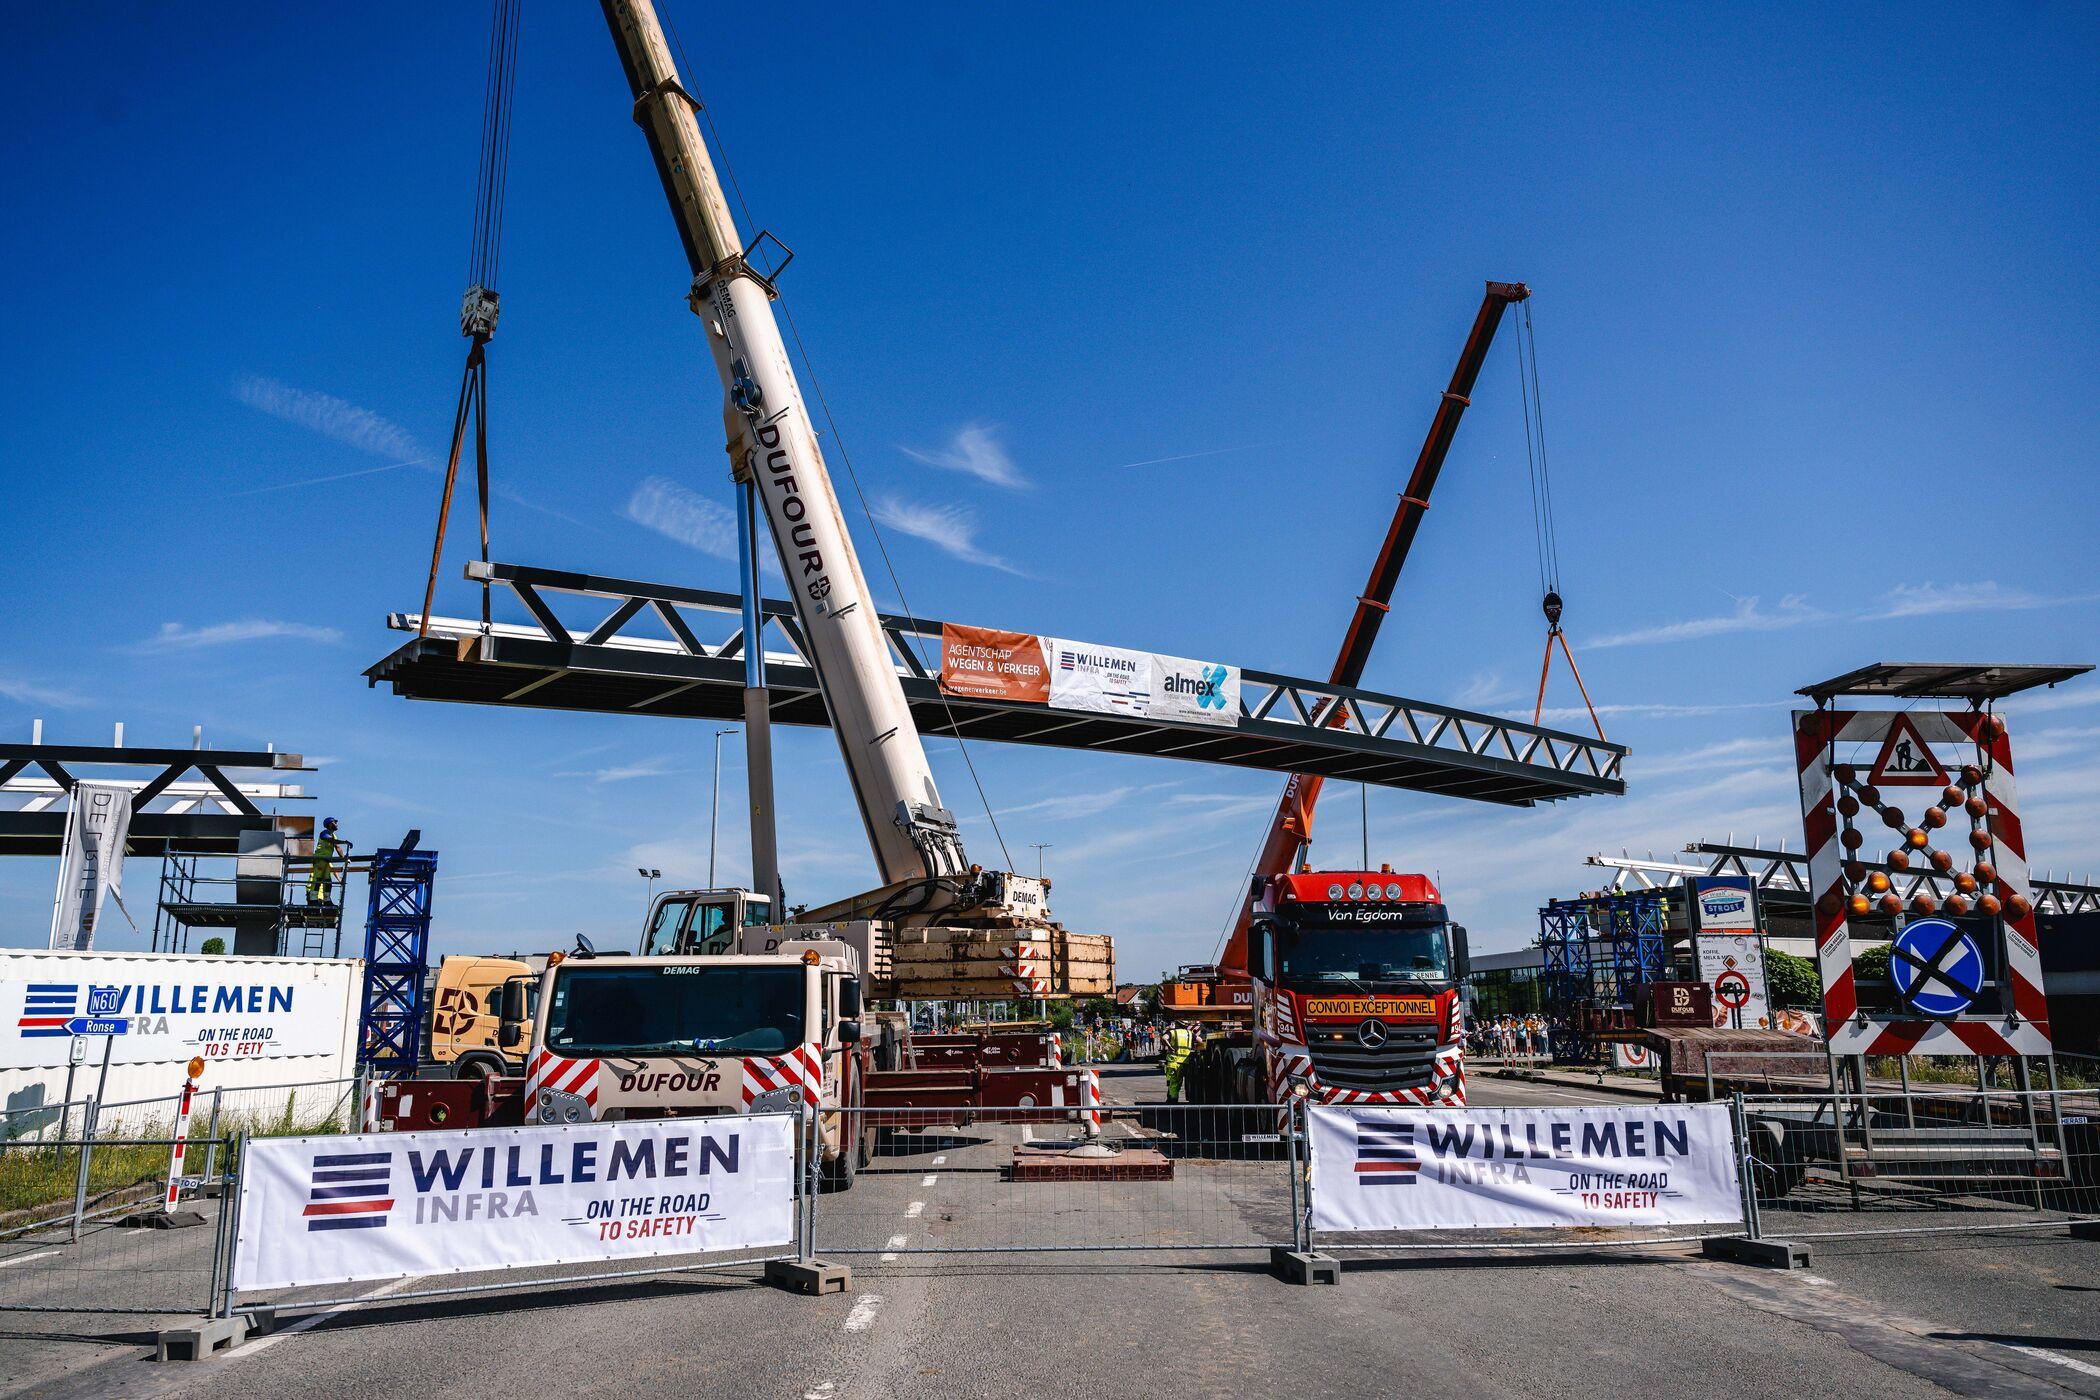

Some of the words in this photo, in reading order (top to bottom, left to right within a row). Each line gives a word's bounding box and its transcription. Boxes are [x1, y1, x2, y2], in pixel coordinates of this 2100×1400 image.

[717, 280, 736, 317] DEMAG
[757, 424, 824, 577] DUFOUR
[948, 643, 1012, 660] AGENTSCHAP
[948, 657, 984, 671] WEGEN
[986, 661, 994, 672] &
[997, 662, 1040, 676] VERKEER
[1077, 653, 1136, 672] WILLEMEN
[1077, 664, 1100, 674] INFRA
[1164, 672, 1216, 697] almex
[1012, 891, 1037, 905] DEMAG
[1708, 903, 1740, 912] STROET
[1328, 909, 1353, 921] Van
[1355, 909, 1403, 923] Egdom
[663, 966, 700, 975] DEMAG
[92, 992, 117, 1011] N60
[1307, 1001, 1350, 1014] CONVOI
[1354, 1001, 1435, 1014] EXCEPTIONNEL
[86, 1020, 115, 1033] Ronse
[198, 1028, 216, 1042] ON
[219, 1028, 240, 1041] THE
[242, 1027, 273, 1041] ROAD
[205, 1043, 219, 1056] TO
[620, 1073, 721, 1093] DUFOUR
[1425, 1120, 1689, 1159] WILLEMEN
[407, 1133, 740, 1193] WILLEMEN
[1438, 1161, 1532, 1185] INFRA
[1569, 1173, 1591, 1190] ON
[1595, 1173, 1624, 1190] THE
[1627, 1172, 1668, 1189] ROAD
[415, 1190, 539, 1225] INFRA
[586, 1199, 615, 1219] ON
[620, 1196, 655, 1216] THE
[659, 1192, 710, 1214] ROAD
[1581, 1192, 1600, 1210] TO
[1604, 1191, 1658, 1210] SAFETY
[599, 1220, 622, 1241] TO
[627, 1215, 697, 1240] SAFETY
